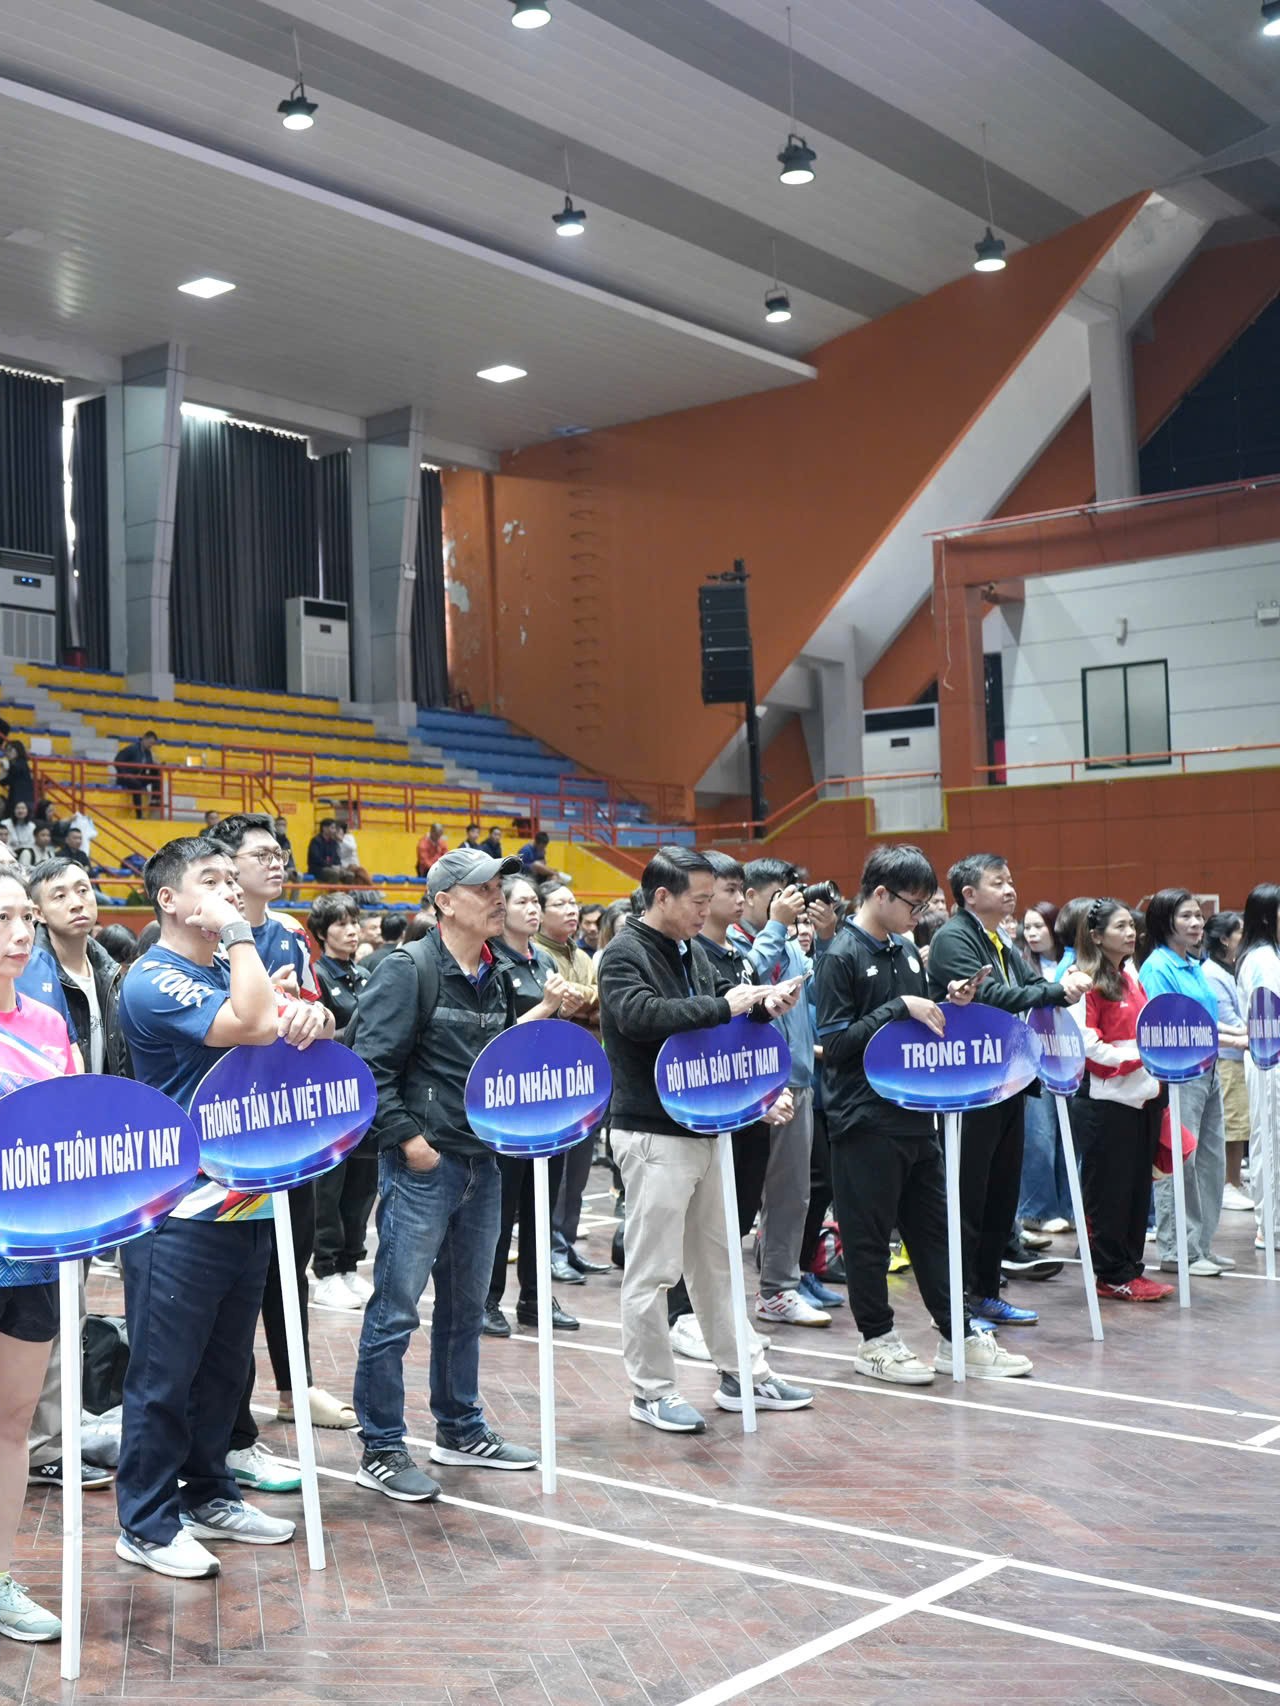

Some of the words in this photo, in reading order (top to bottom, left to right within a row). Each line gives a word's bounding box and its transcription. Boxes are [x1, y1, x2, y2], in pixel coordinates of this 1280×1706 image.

[901, 1040, 966, 1073] TRỌNG
[971, 1033, 1002, 1065] TÀI
[1140, 1021, 1150, 1052] HỘI
[1151, 1021, 1163, 1047] NHÀ
[1163, 1021, 1177, 1047] BÁO
[1190, 1020, 1214, 1047] PHÒNG
[484, 1068, 515, 1109] BÁO
[519, 1063, 562, 1104] NHÂN
[565, 1059, 595, 1098] DÂN
[666, 1057, 685, 1097] HỘI
[685, 1052, 709, 1088] NHÀ
[709, 1050, 731, 1085] BÁO
[732, 1045, 753, 1085] VIỆT
[755, 1046, 779, 1076] NAM
[199, 1093, 242, 1141] THÔNG
[242, 1081, 271, 1131] TẤN
[271, 1082, 292, 1126] XÃ
[292, 1078, 322, 1127] VIỆT
[325, 1078, 360, 1116] NAM
[1, 1138, 51, 1191] NÔNG
[54, 1130, 97, 1183] THÔN
[100, 1123, 145, 1176] NGÀY
[148, 1126, 181, 1169] NAY
